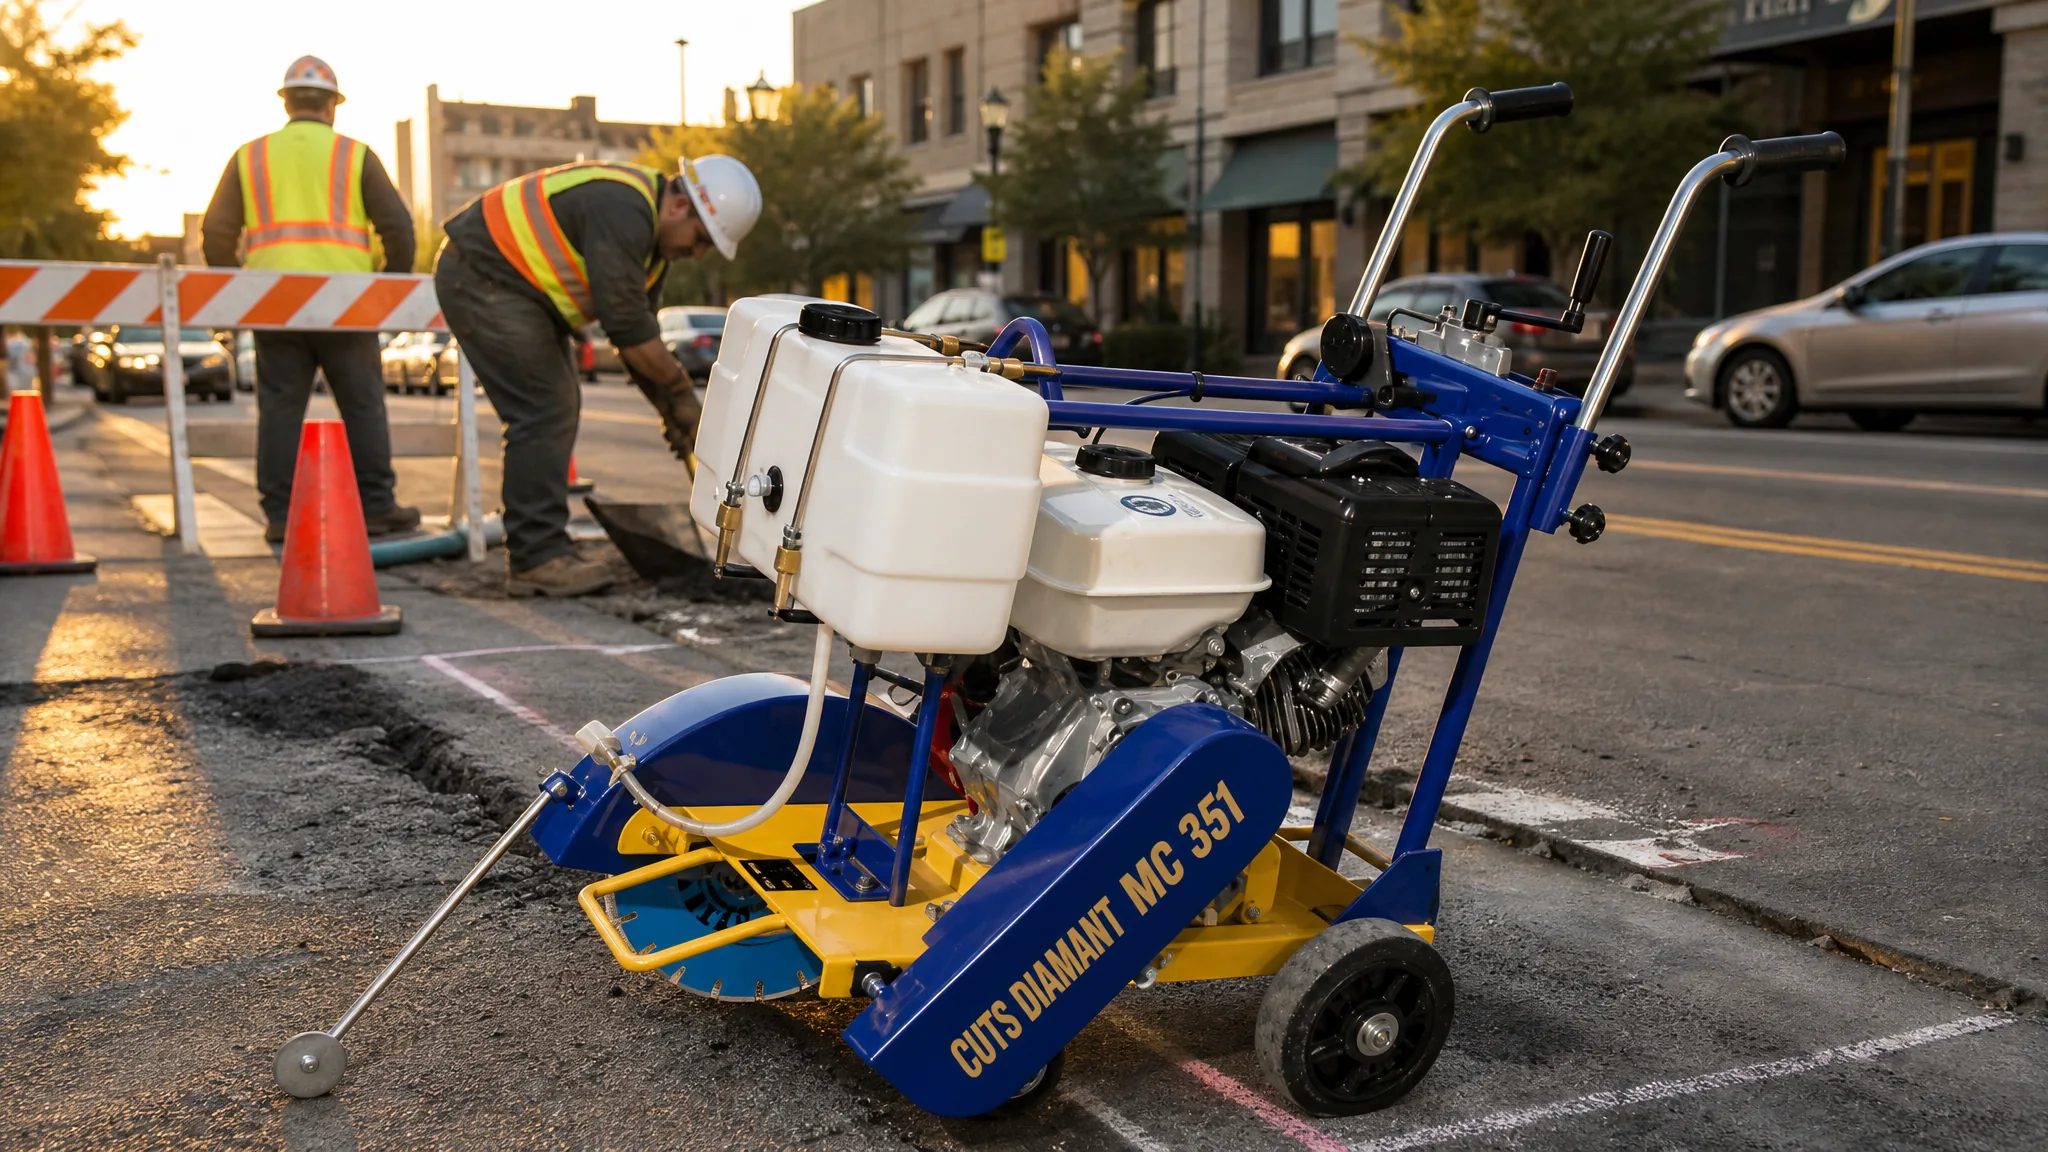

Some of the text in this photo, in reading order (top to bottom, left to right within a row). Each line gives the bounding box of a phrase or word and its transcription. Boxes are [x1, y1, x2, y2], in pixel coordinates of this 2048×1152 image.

[951, 780, 1245, 1078] CUTS DIAMANT MC 351
